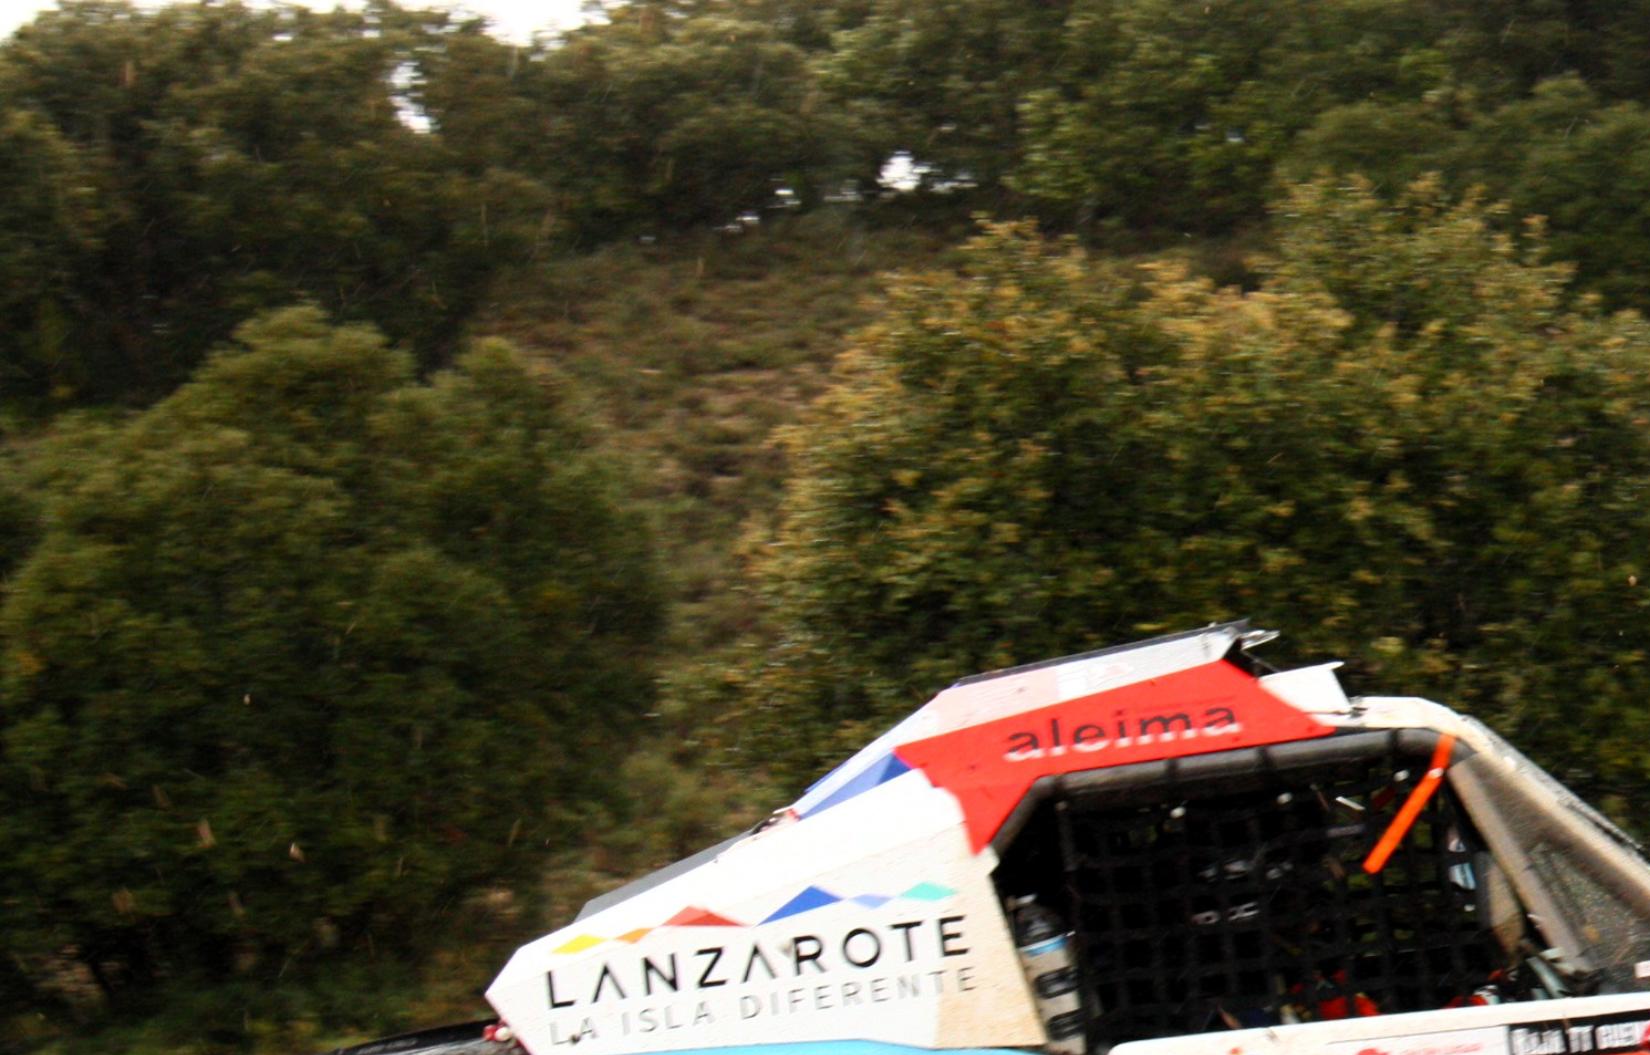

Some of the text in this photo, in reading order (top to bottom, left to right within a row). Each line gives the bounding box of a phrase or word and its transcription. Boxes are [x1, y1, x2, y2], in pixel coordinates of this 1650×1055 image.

[1004, 706, 1243, 761] aleima
[543, 915, 970, 1009] LANZAROTE
[549, 966, 977, 1046] LA ISLA DIFERENTE
